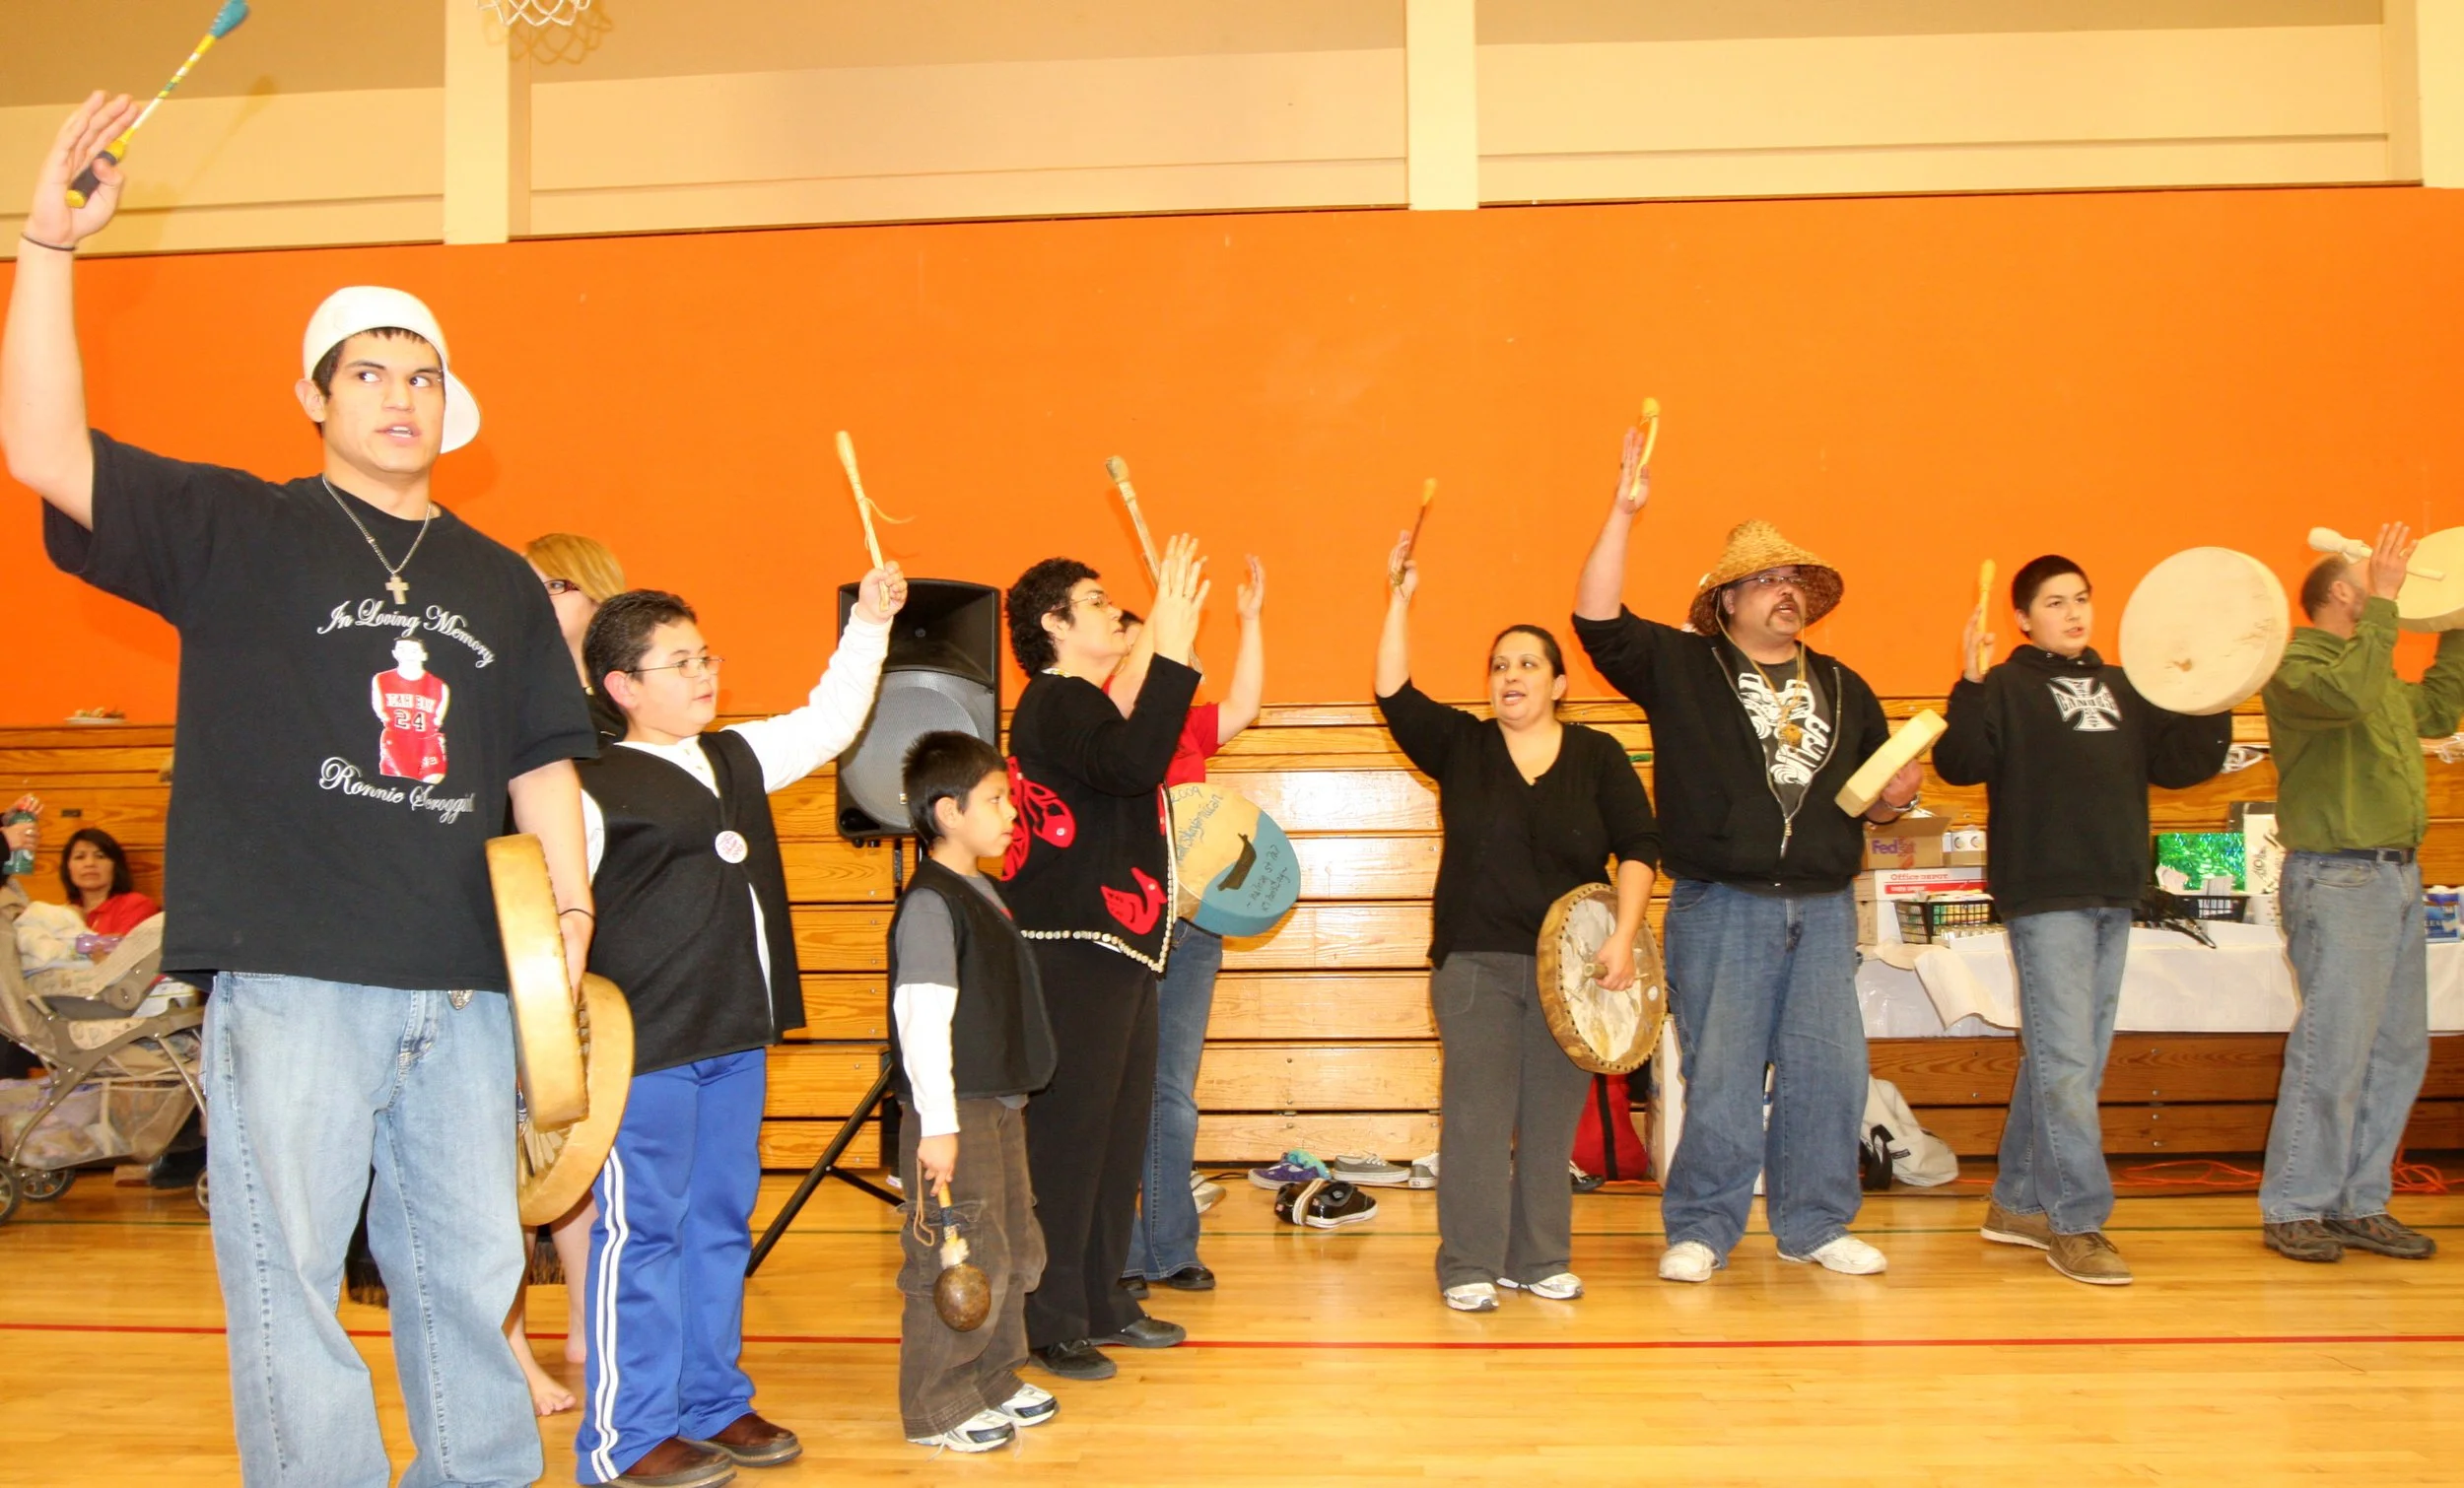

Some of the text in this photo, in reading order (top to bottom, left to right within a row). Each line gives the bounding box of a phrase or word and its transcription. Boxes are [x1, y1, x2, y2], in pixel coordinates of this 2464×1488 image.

[317, 598, 495, 668] In Loving Memory
[394, 710, 426, 732] 24
[318, 756, 405, 804] Ronnie
